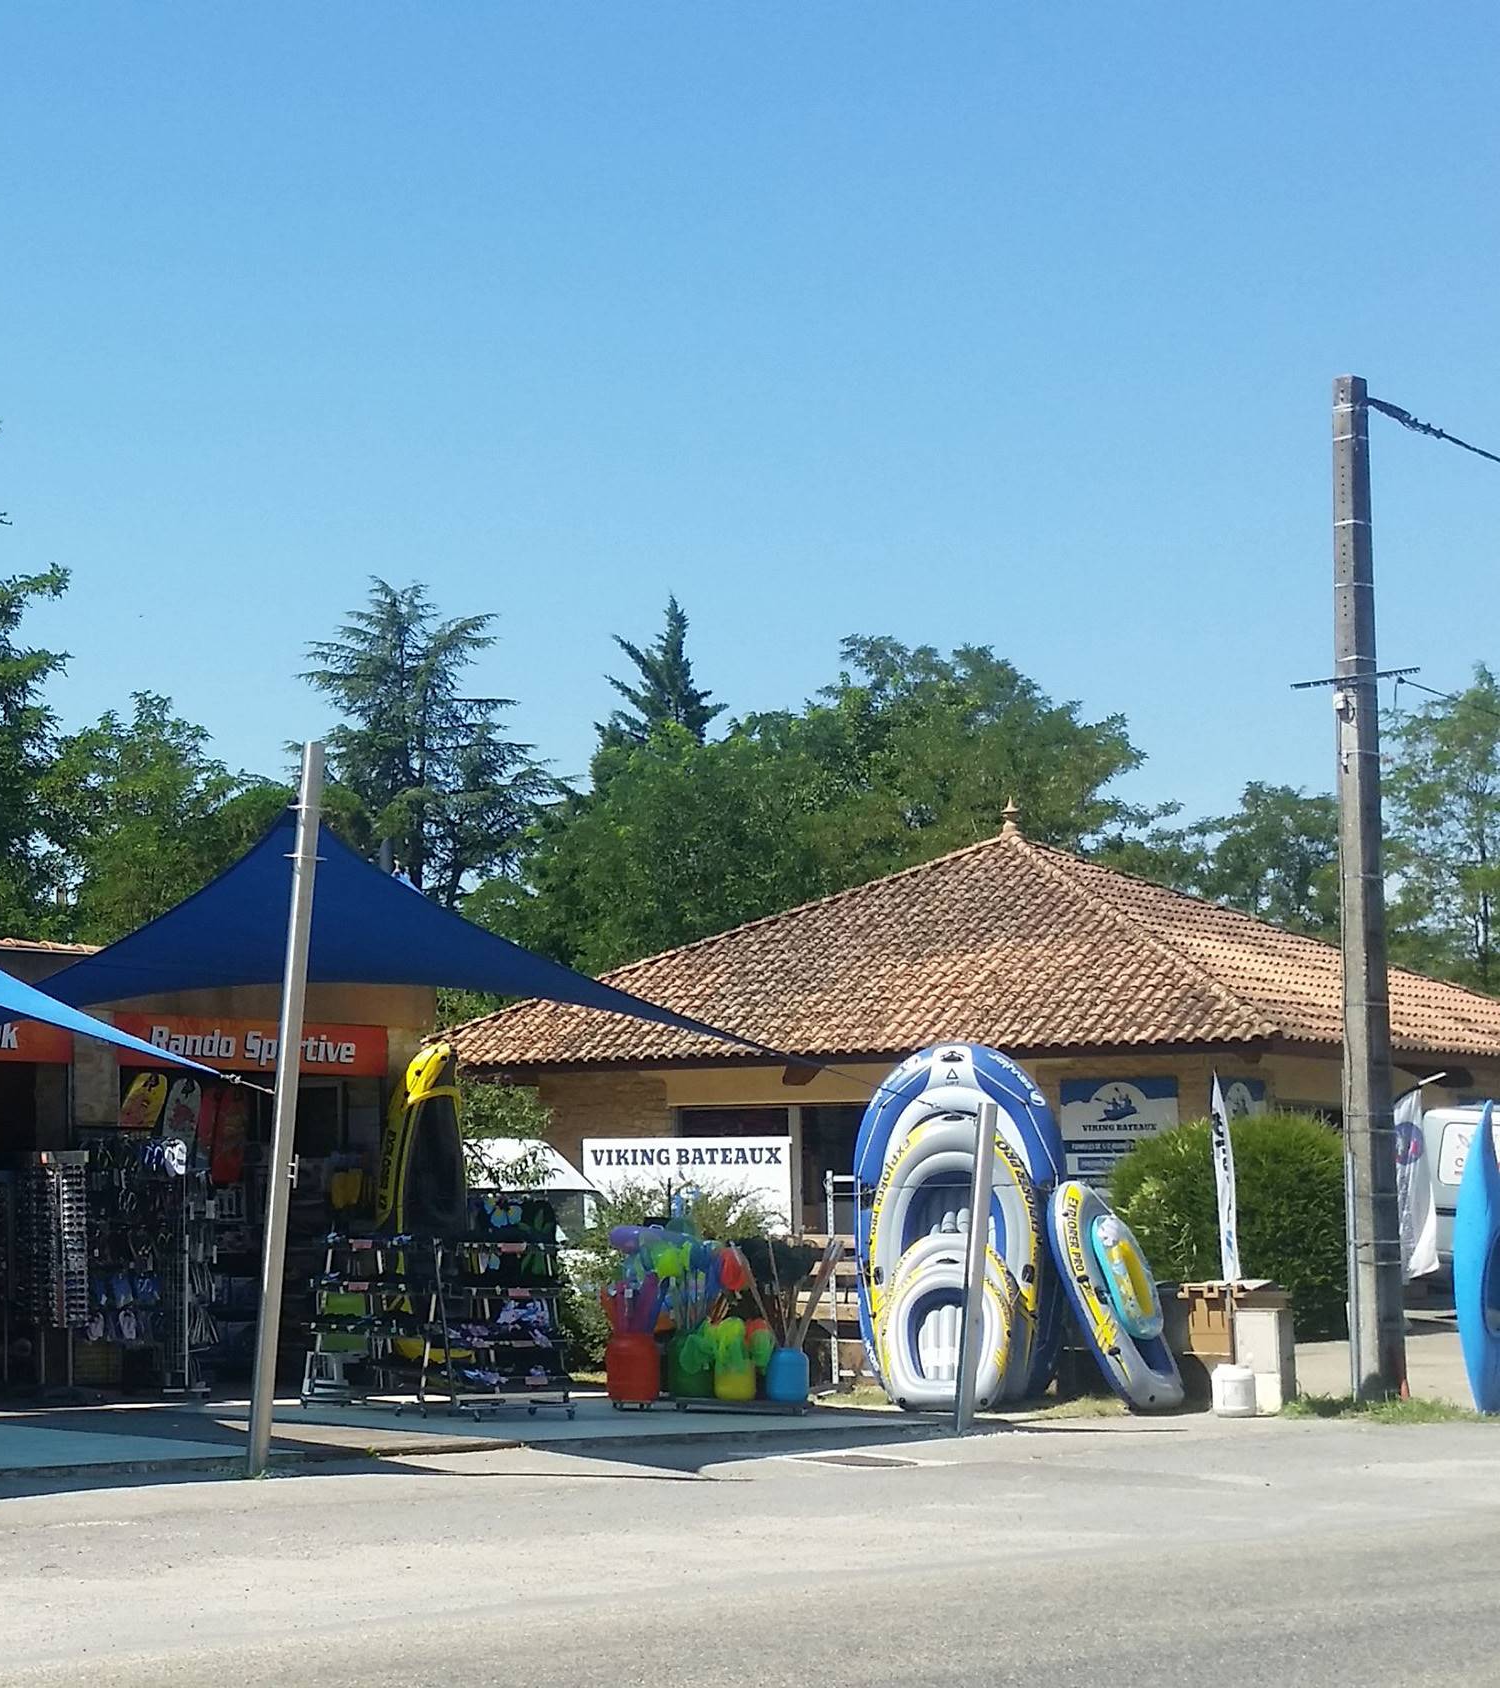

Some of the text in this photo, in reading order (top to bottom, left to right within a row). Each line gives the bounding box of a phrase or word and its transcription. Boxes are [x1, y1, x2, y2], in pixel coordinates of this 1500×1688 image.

[150, 1026, 356, 1066] Rando Sptive
[591, 1147, 782, 1166] VIKING BATEAUX
[1071, 1251, 1085, 1272] PRO
